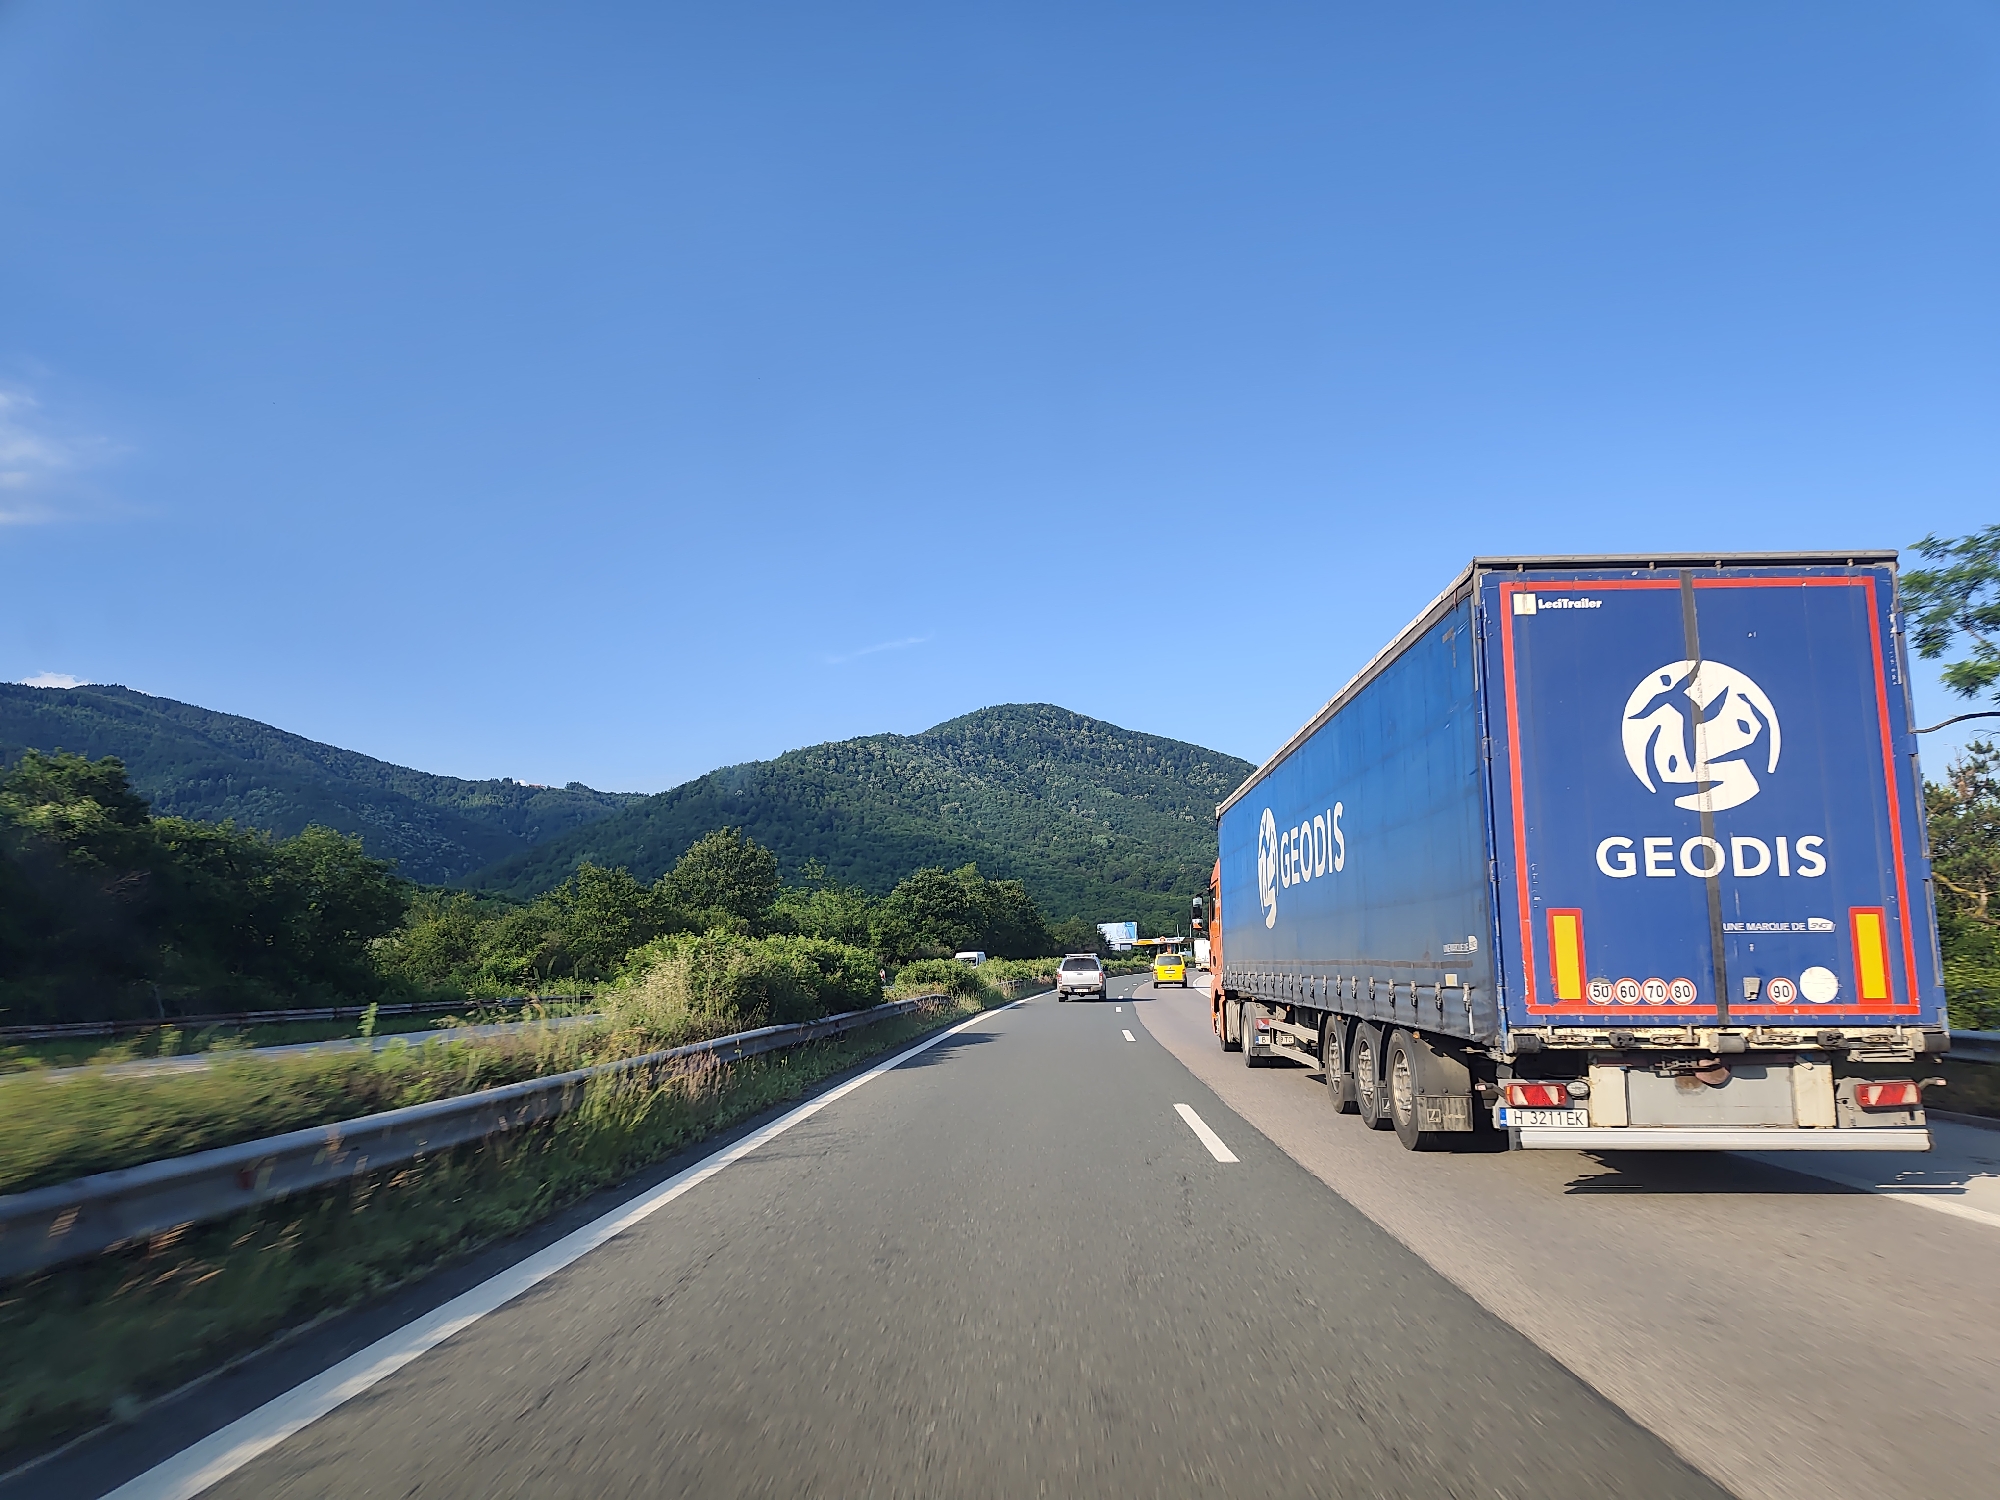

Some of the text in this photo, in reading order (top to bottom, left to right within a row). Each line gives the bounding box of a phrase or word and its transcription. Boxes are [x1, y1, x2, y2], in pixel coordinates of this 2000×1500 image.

[1538, 598, 1602, 609] LeciTrailer
[1281, 801, 1345, 889] GEODIS
[1595, 835, 1827, 878] GEODIS
[1722, 922, 1745, 931] UNE
[1746, 922, 1790, 931] MARQUE
[1791, 922, 1806, 931] DE
[1593, 985, 1609, 998] 50
[1620, 985, 1636, 998] 60
[1647, 985, 1664, 998] 70
[1674, 985, 1691, 998] 80
[1773, 985, 1790, 998] 90
